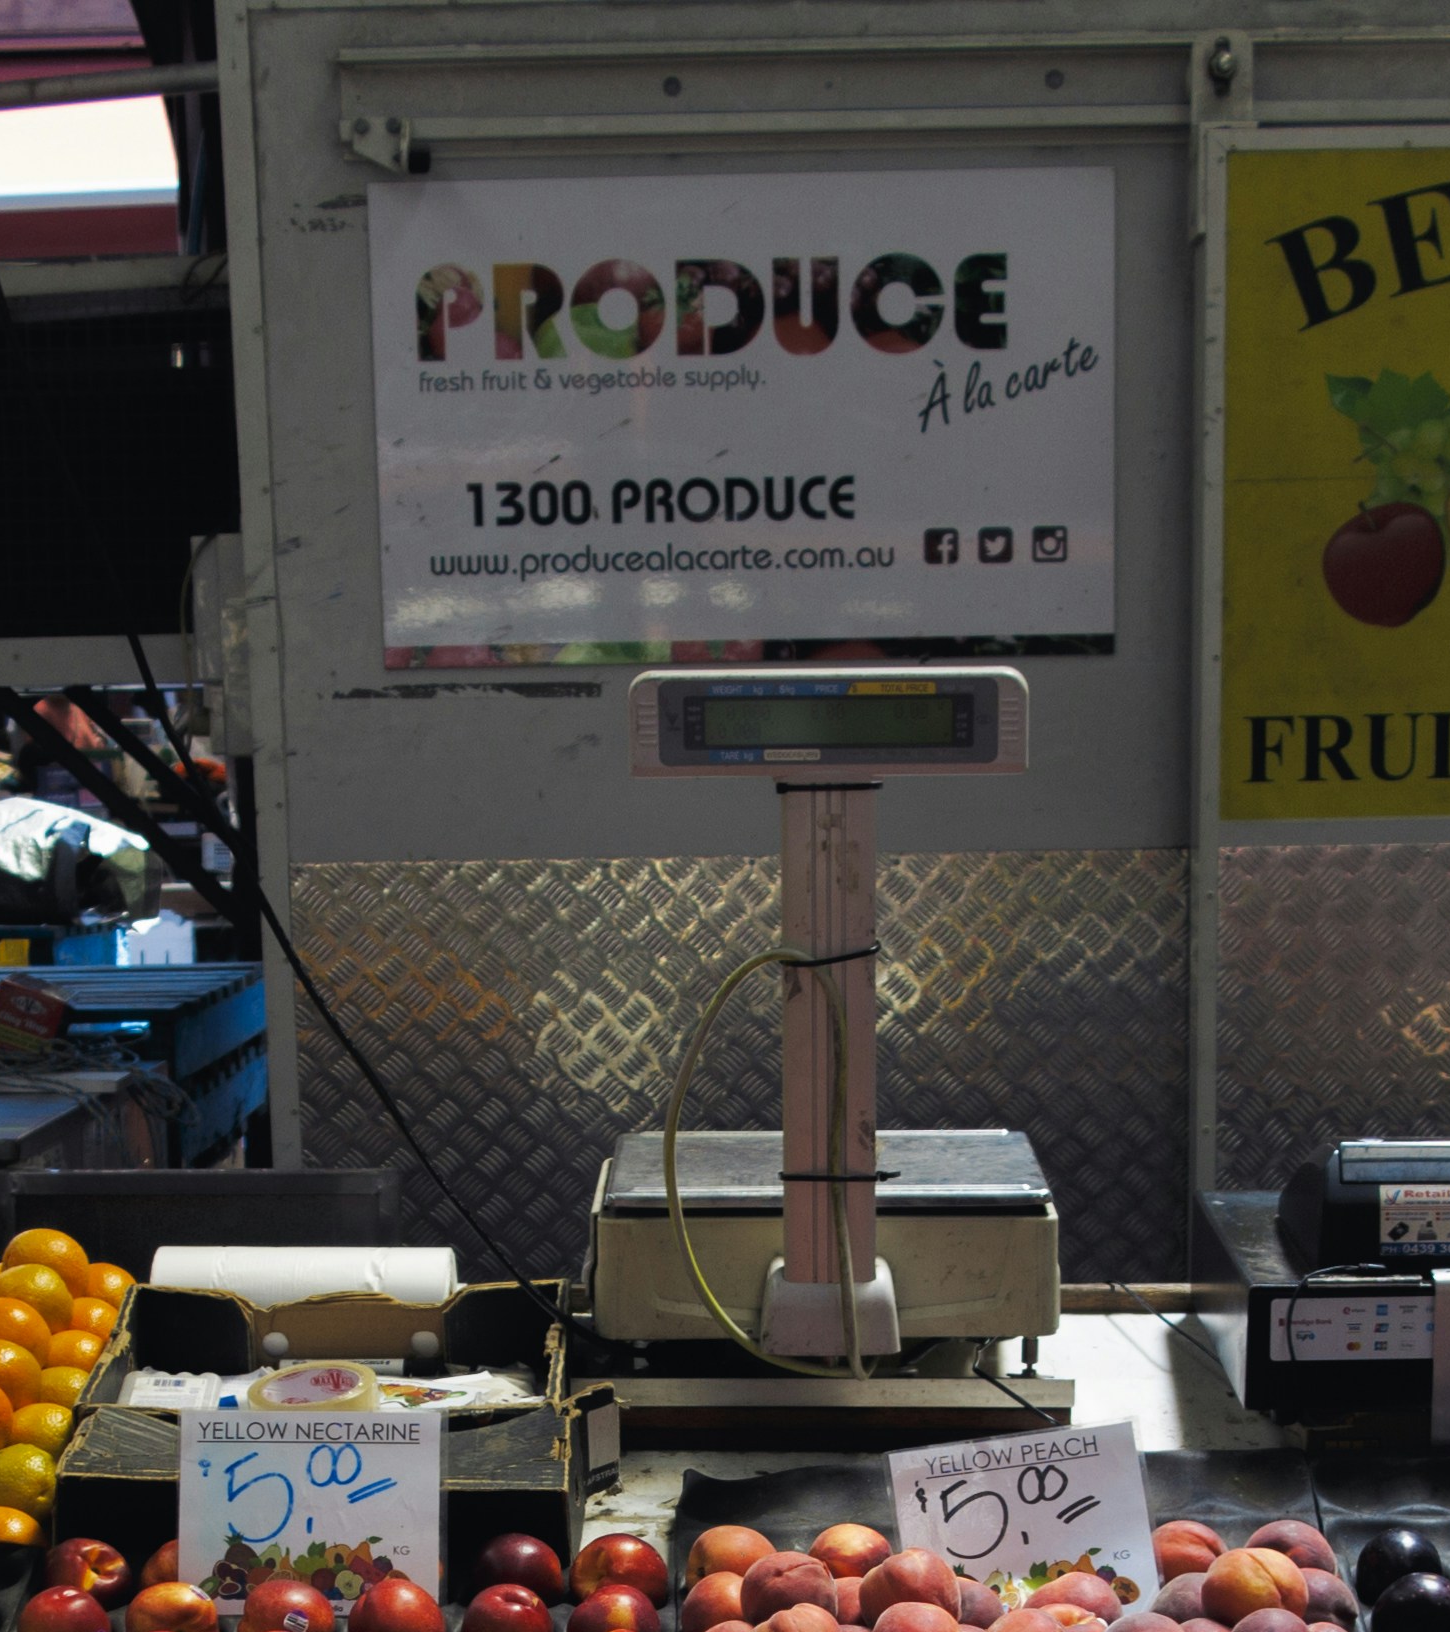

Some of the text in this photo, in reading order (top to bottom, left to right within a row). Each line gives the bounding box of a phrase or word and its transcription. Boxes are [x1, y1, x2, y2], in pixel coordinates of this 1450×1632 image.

[415, 251, 1009, 362] PRODUCE
[419, 364, 767, 396] fresh fruit & vegetable supply.
[916, 335, 1099, 434] À la carte
[464, 474, 856, 528] 1300 PRODUCE
[429, 542, 896, 582] www.producealacarte.com.au
[815, 684, 839, 694] PRICE
[880, 684, 904, 693] TOTAL
[906, 683, 929, 693] PRICE
[1402, 1244, 1436, 1254] 0439
[199, 1421, 420, 1441] YELLOW NECTARINE
[924, 1435, 1099, 1476] YELLOW PEACH
[393, 1546, 410, 1556] KG
[1113, 1550, 1131, 1561] KG
